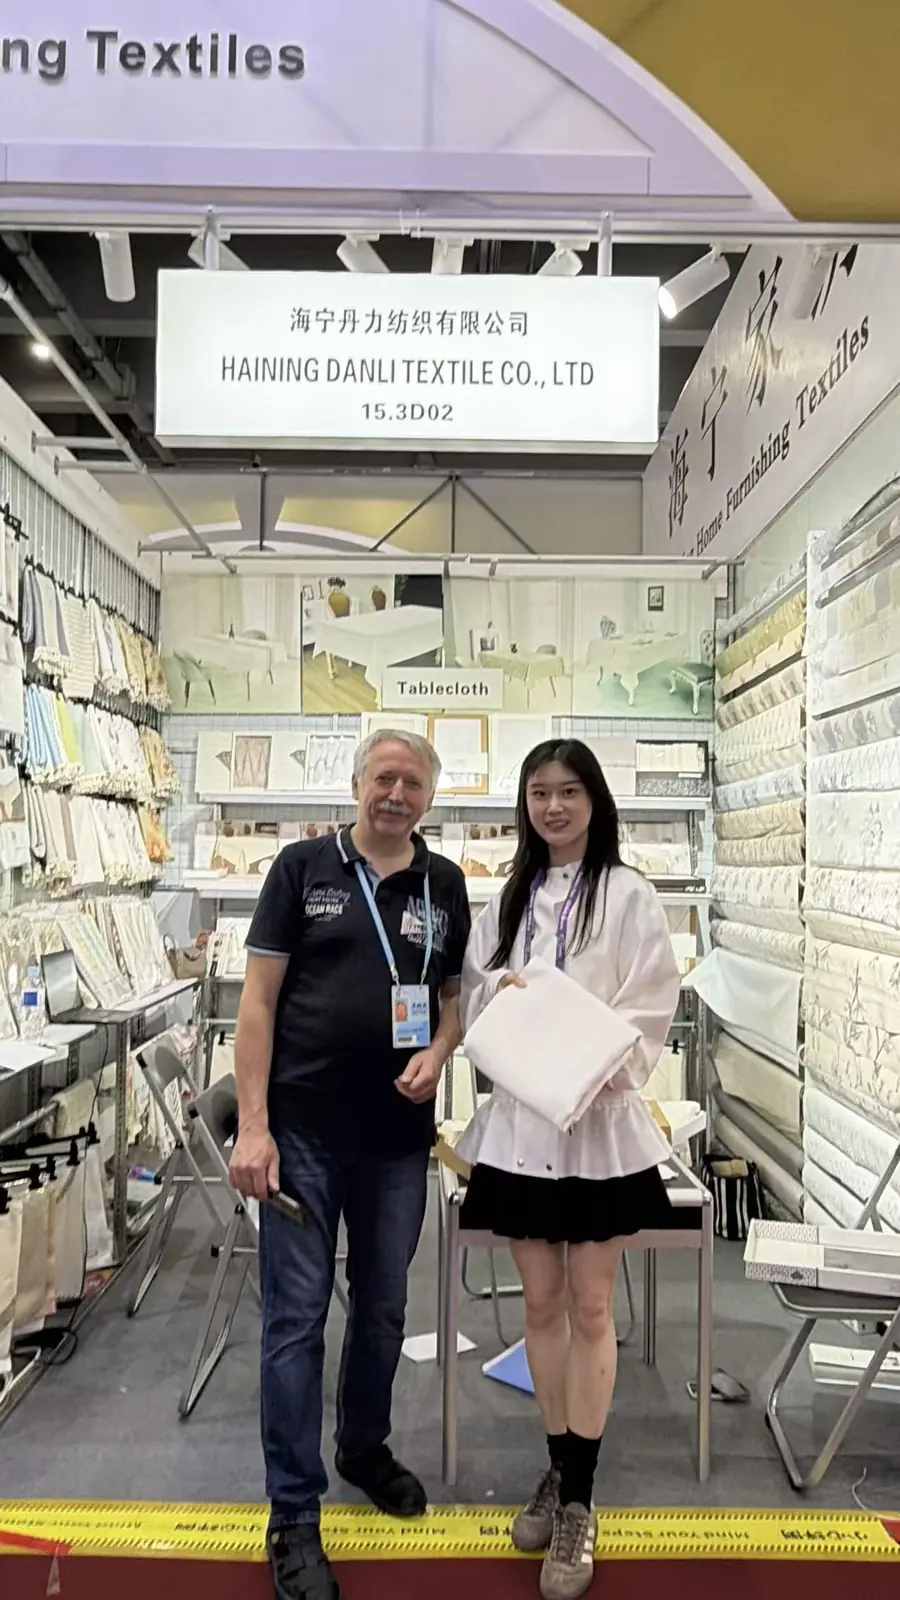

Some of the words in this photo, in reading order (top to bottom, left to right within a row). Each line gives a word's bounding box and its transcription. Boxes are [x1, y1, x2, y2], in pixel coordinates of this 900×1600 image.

[2, 38, 67, 80] ng
[86, 29, 305, 79] Textiles
[290, 307, 528, 336] 海宁丹力纺织有限公司
[221, 356, 319, 382] HAINING
[327, 358, 395, 383] DANLI
[402, 360, 494, 385] TEXTILE
[501, 360, 545, 389] CO.,
[553, 361, 594, 386] LTD
[362, 403, 453, 421] 15.3D02
[695, 510, 724, 557] Home
[725, 419, 792, 522] Furnishing
[795, 314, 869, 431] Textiles
[397, 681, 489, 695] Tablecloth
[305, 903, 325, 916] OCEAN
[326, 903, 343, 915] RACE
